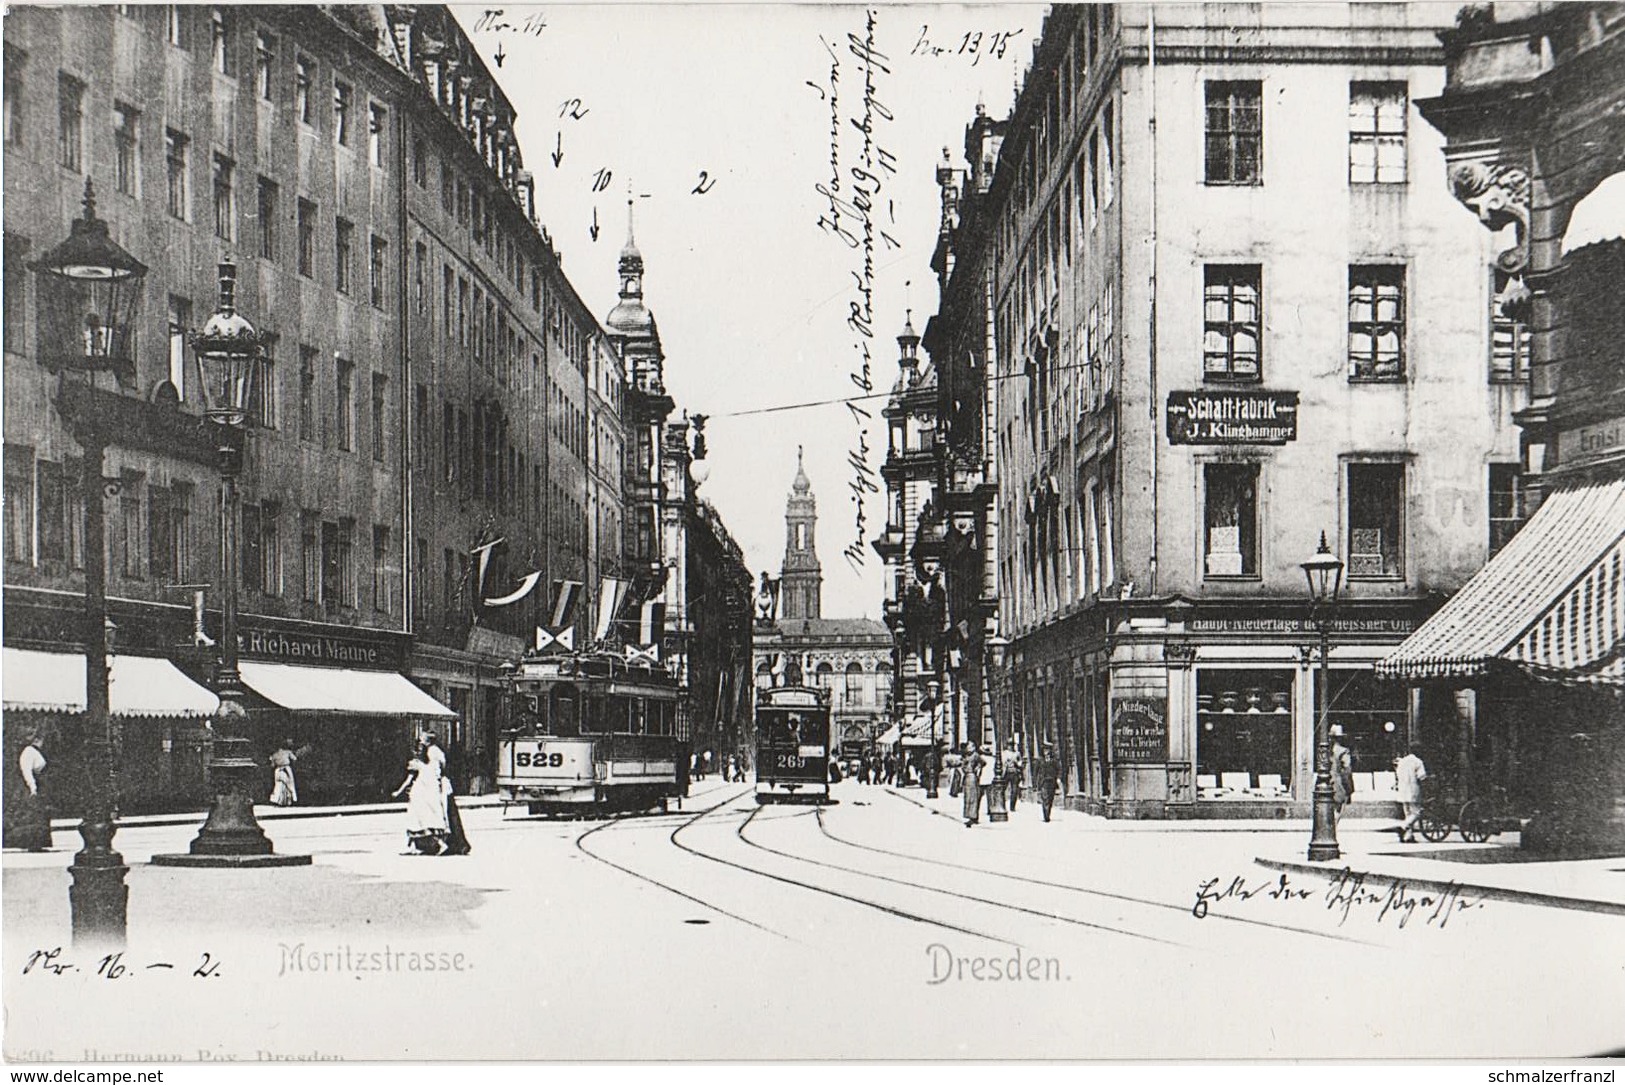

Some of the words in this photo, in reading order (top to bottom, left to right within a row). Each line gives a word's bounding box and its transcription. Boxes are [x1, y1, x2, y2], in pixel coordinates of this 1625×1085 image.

[523, 12, 548, 37] 14
[559, 98, 590, 121] 12
[592, 167, 613, 193] 10
[691, 171, 717, 195] 2
[1186, 422, 1207, 438] J.
[1209, 422, 1294, 441] Klinghammer
[250, 632, 322, 657] Richard
[325, 639, 378, 663] Maune
[516, 752, 564, 768] 529
[777, 754, 806, 769] 269
[193, 952, 221, 977] 2.
